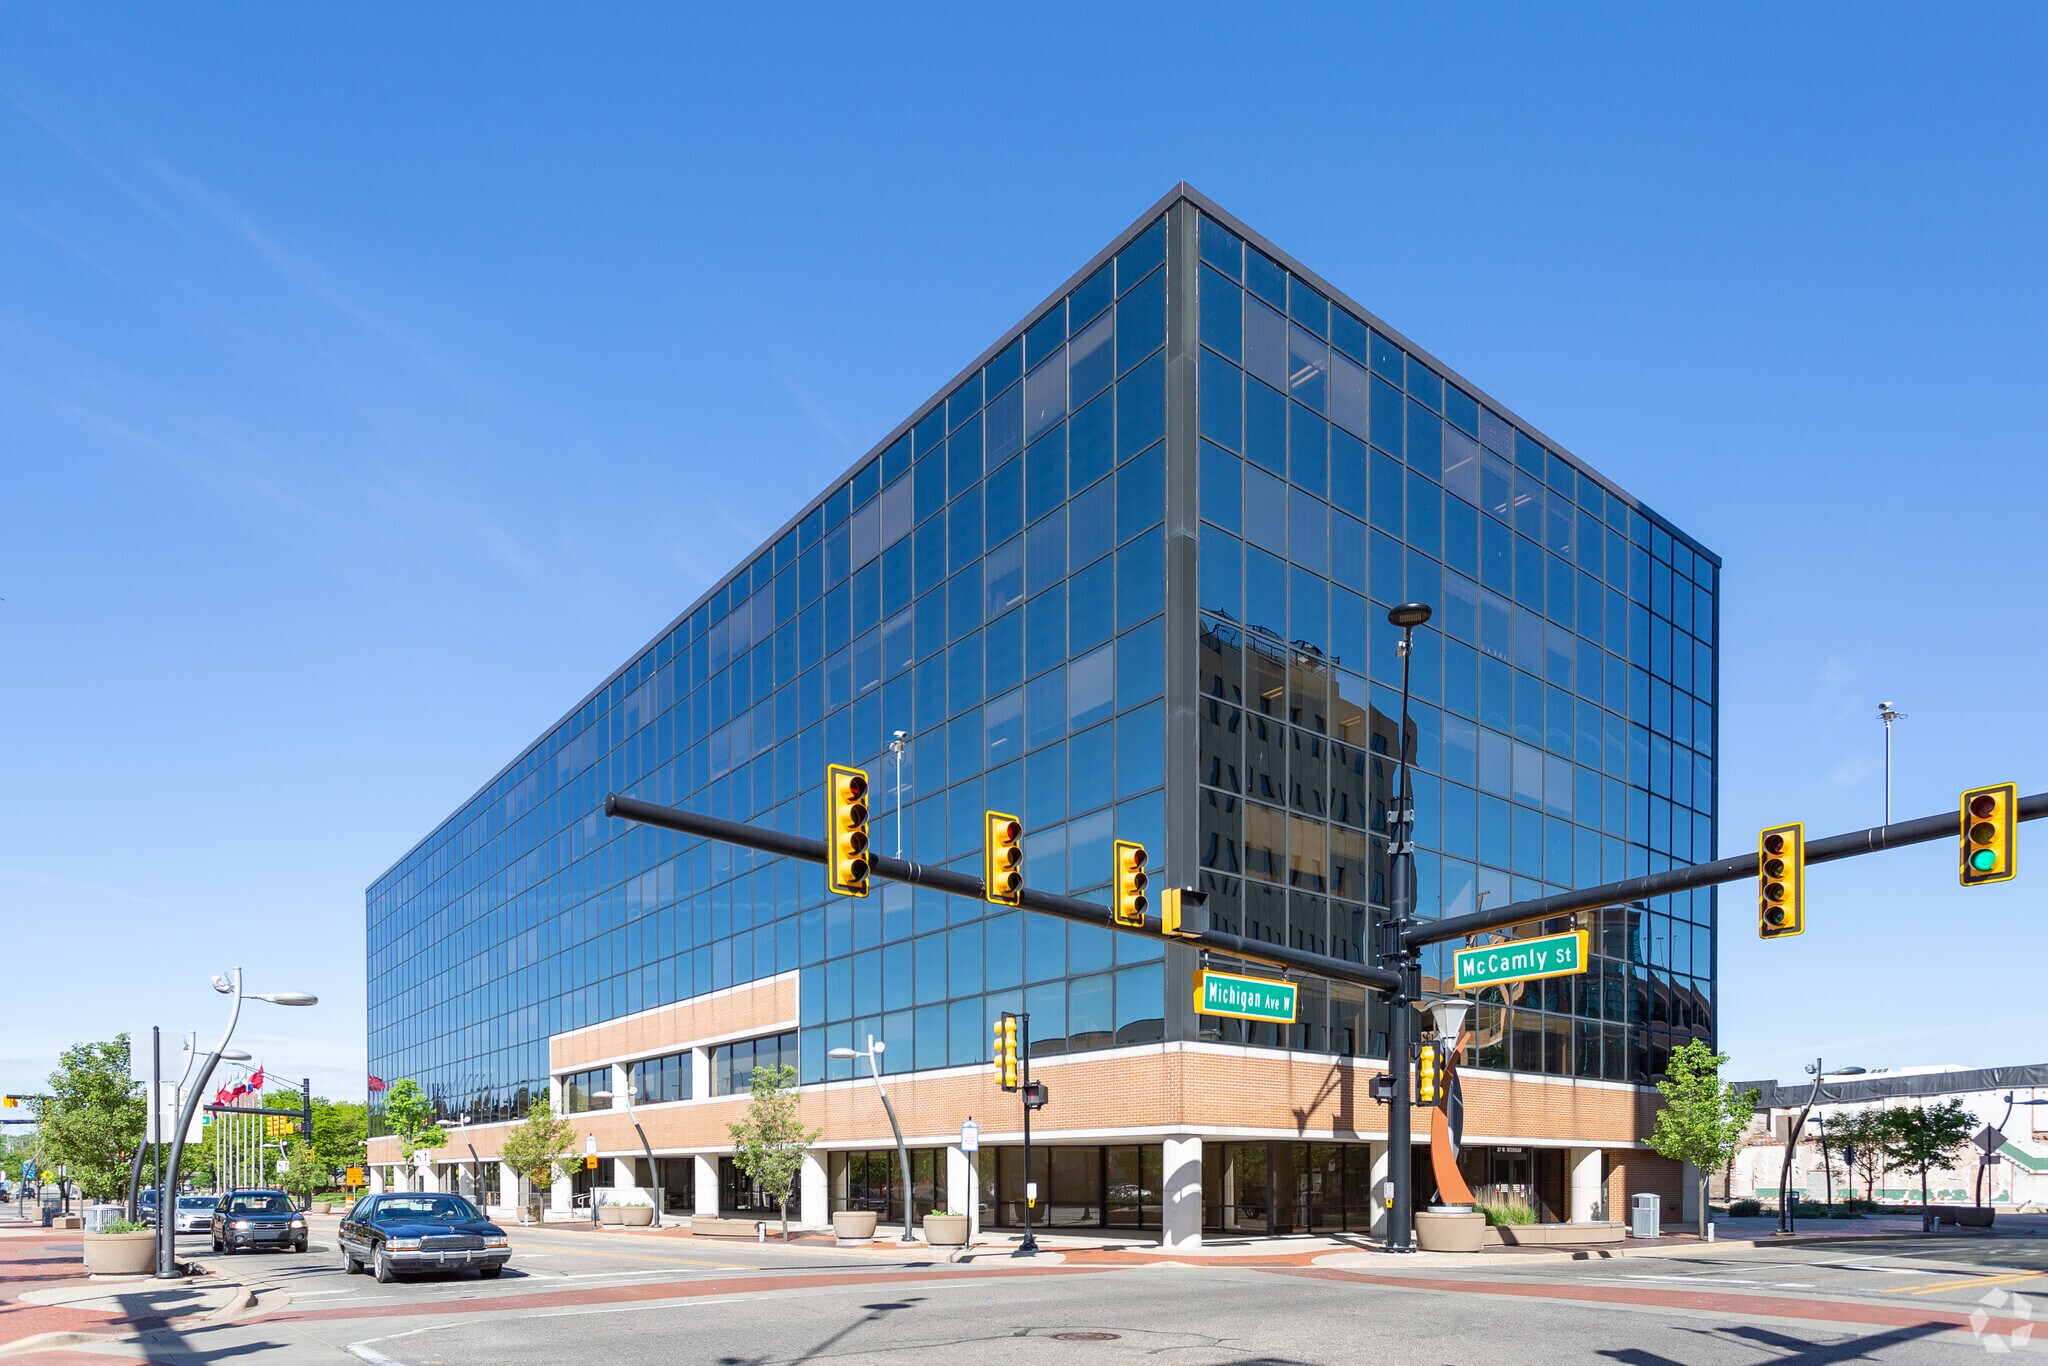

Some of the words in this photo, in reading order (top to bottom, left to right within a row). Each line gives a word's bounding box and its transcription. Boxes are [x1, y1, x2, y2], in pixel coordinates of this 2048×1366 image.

[1463, 948, 1548, 977] McCamly
[1556, 947, 1571, 963] St
[1209, 982, 1260, 1012] Michigan
[1264, 994, 1280, 1010] Ave
[1283, 997, 1290, 1011] W
